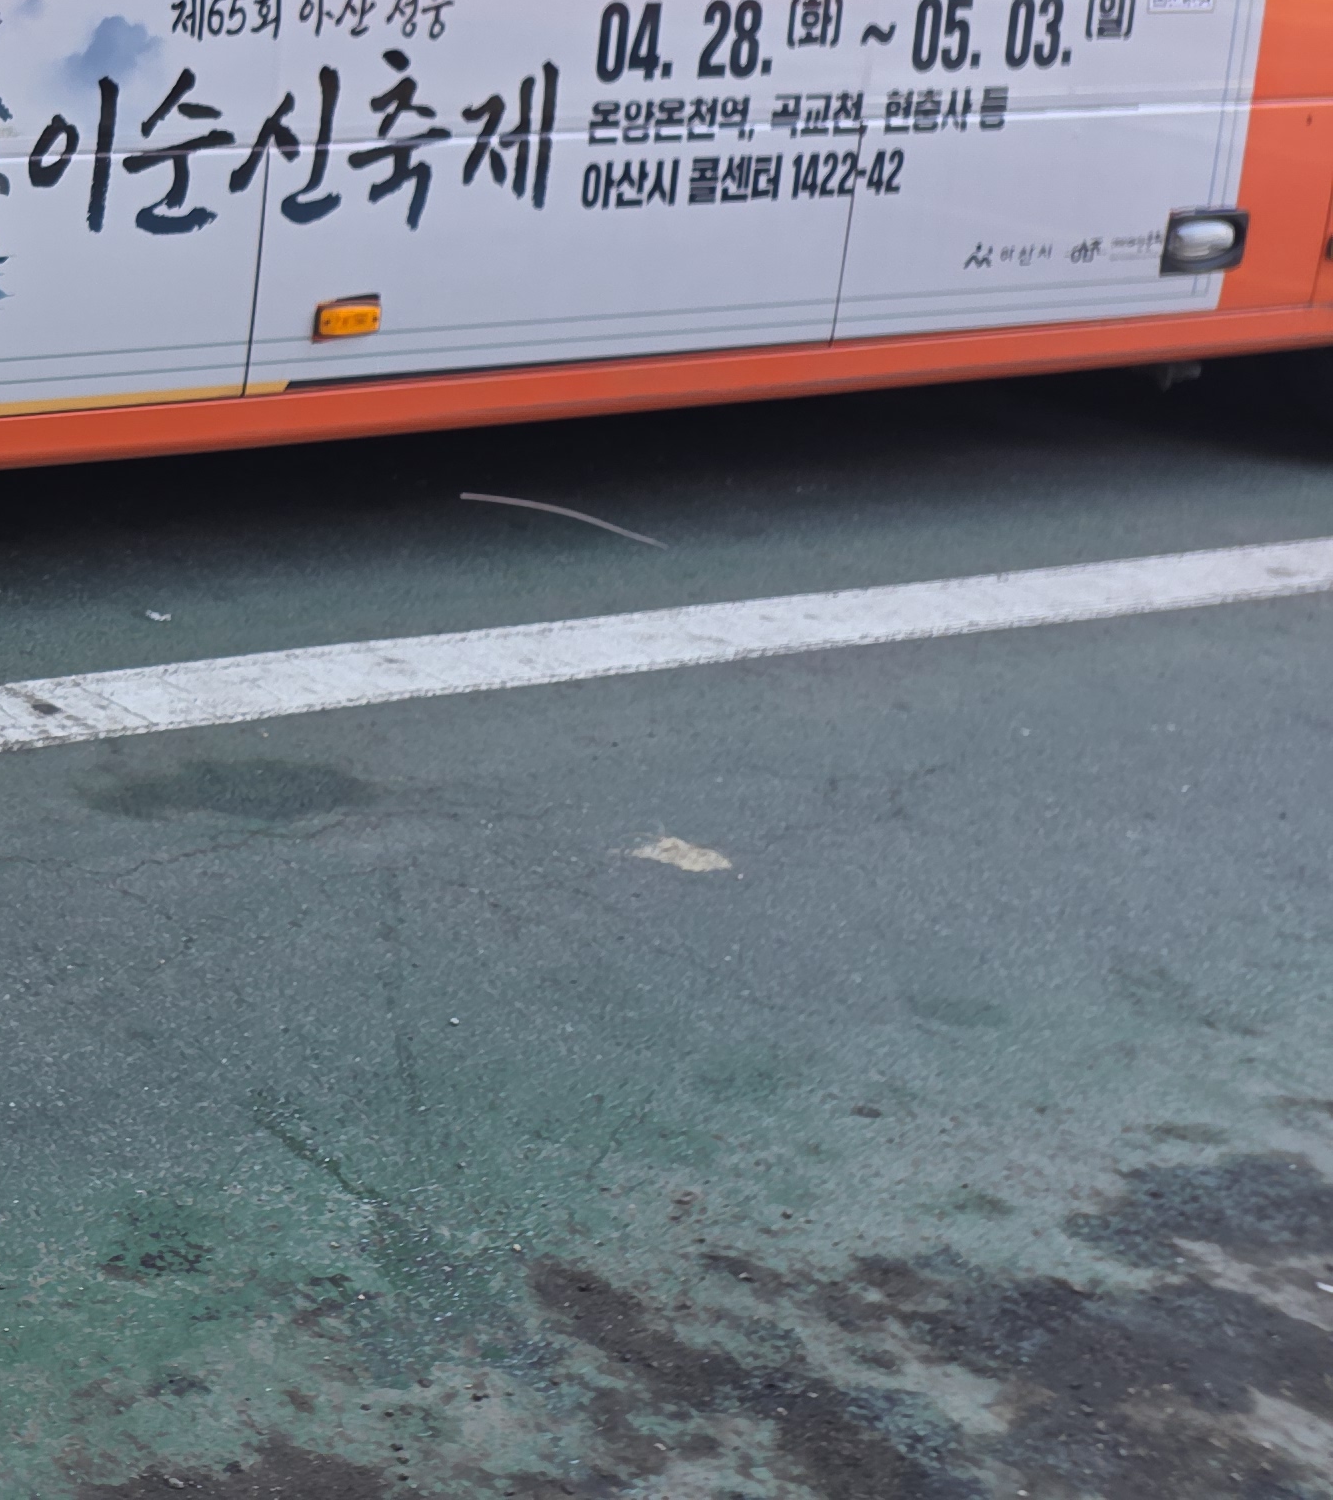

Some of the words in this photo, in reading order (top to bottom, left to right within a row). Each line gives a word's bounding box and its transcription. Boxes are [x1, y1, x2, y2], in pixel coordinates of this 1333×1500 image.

[595, 1, 674, 82] 04.
[860, 21, 897, 46] ~
[28, 48, 561, 237] 이순신축제
[588, 95, 756, 145] 온양온천역,
[771, 91, 869, 137] 곡교천,
[883, 87, 972, 134] 현충사
[978, 85, 1009, 131] 등
[581, 157, 680, 210] 아산시
[688, 152, 783, 204] 콜센터
[791, 147, 905, 200] 1422-42
